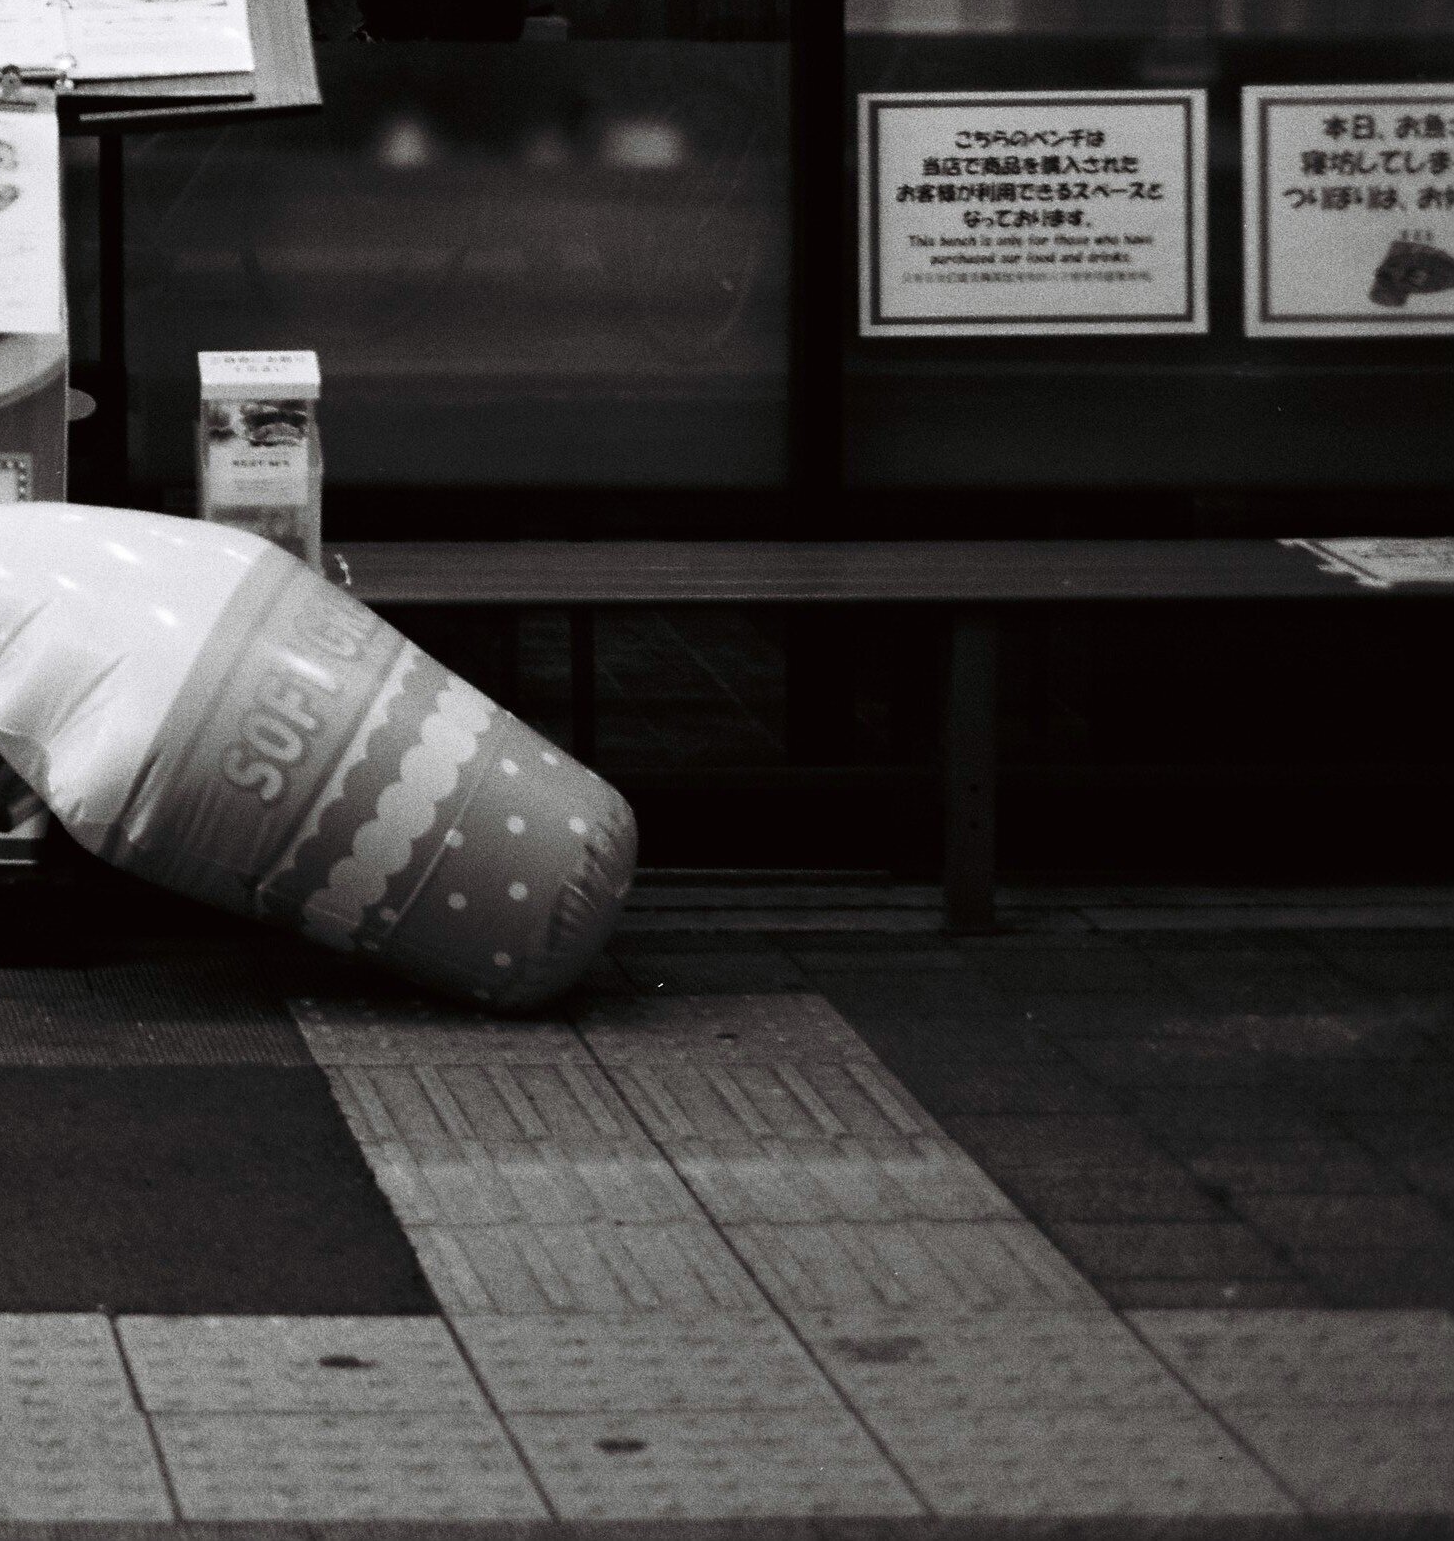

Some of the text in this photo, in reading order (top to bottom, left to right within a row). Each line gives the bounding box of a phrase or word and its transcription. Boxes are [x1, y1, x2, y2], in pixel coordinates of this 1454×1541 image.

[953, 128, 1106, 149] こちらのベンチは
[921, 155, 1139, 177] 当店で商品を購入された
[895, 181, 1165, 203] お客様が利用できるスペースと
[962, 209, 1092, 228] なっております。
[939, 235, 977, 248] bench
